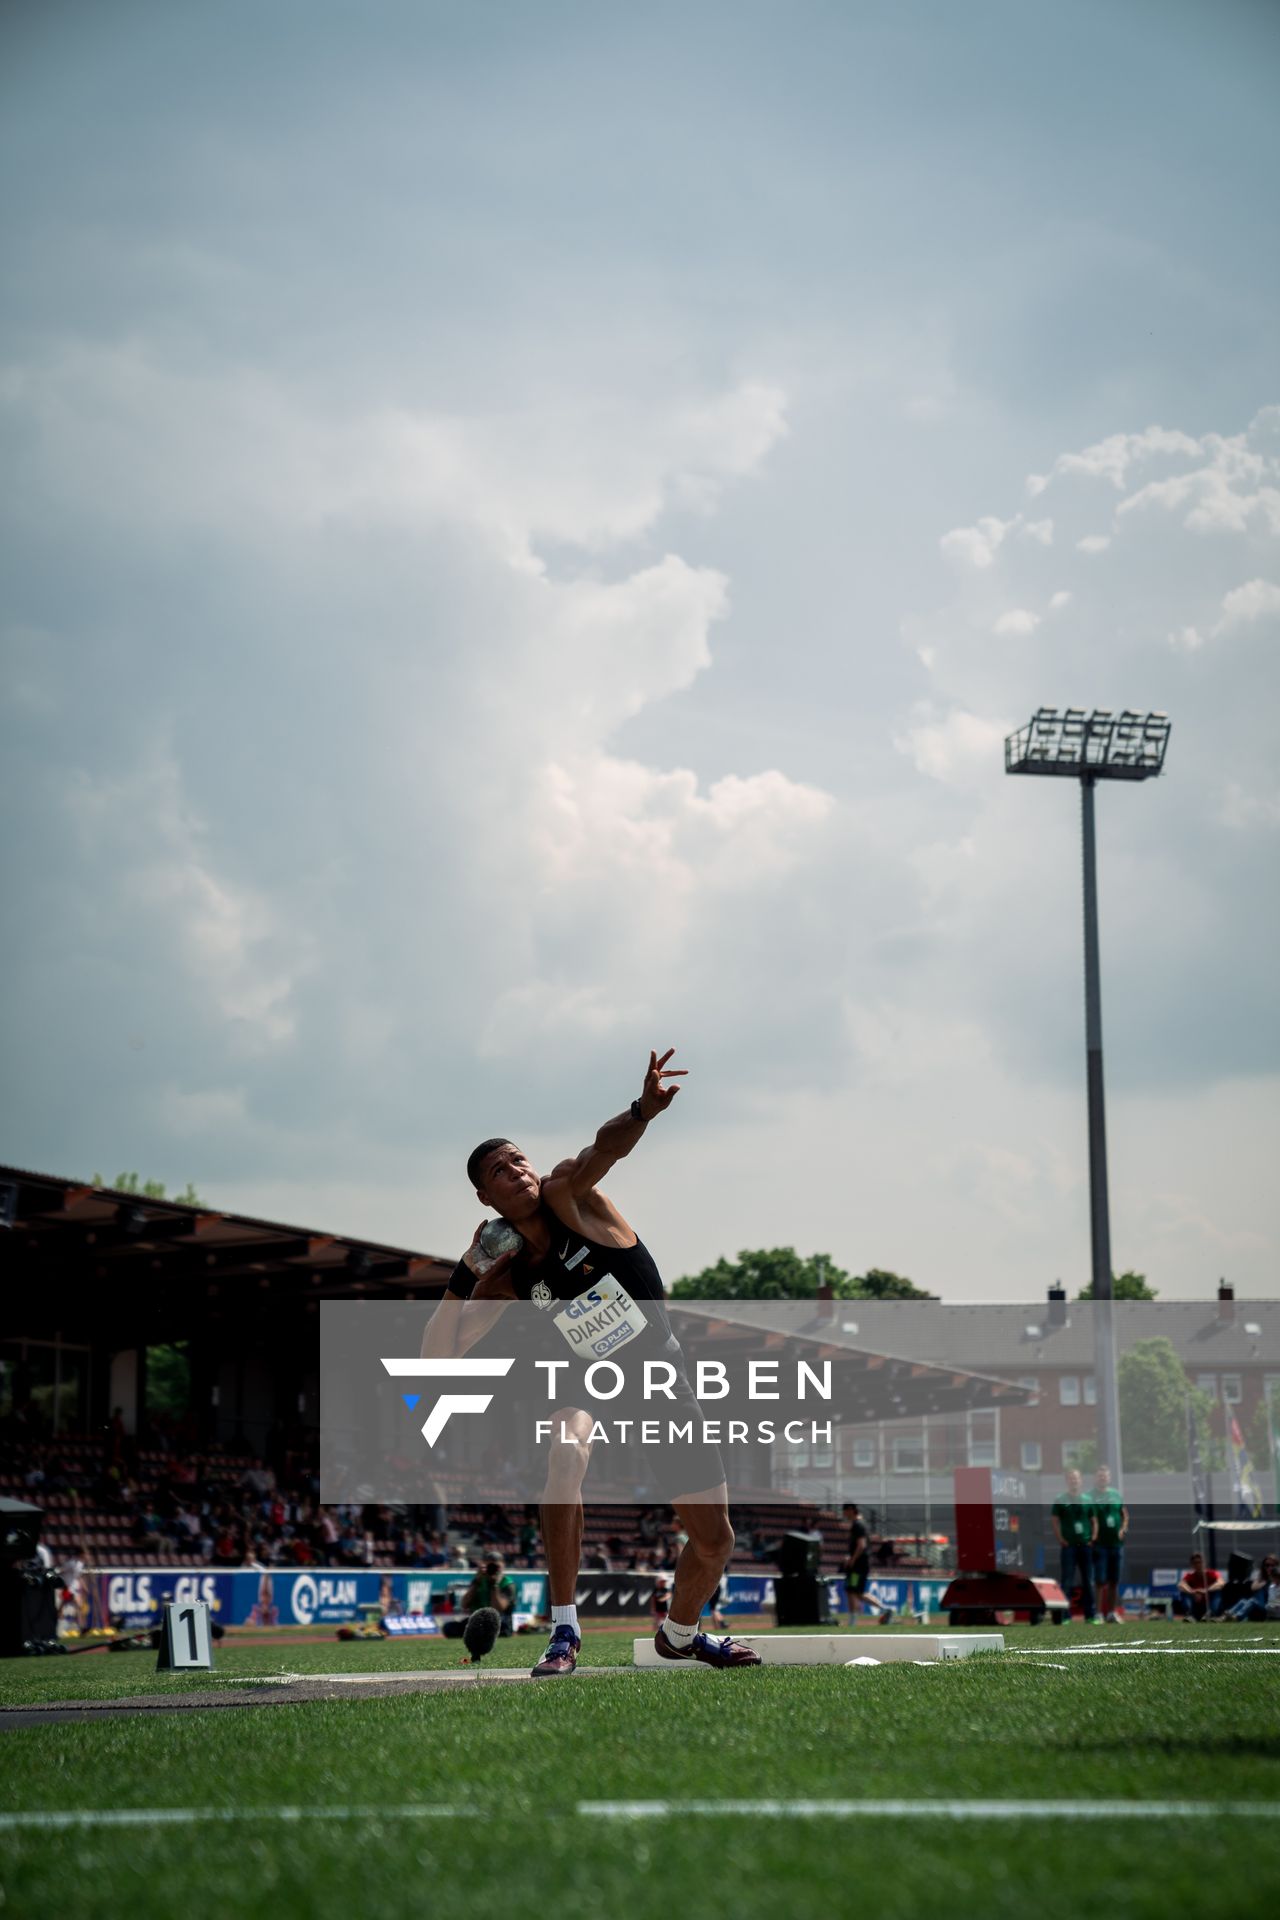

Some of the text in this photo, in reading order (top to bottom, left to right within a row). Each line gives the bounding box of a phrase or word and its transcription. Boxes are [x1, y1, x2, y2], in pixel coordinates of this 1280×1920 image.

[566, 1290, 632, 1345] DIAKITÉ
[607, 1324, 630, 1344] PLAN
[319, 1580, 357, 1605] PLAN
[178, 1608, 199, 1661] 1
